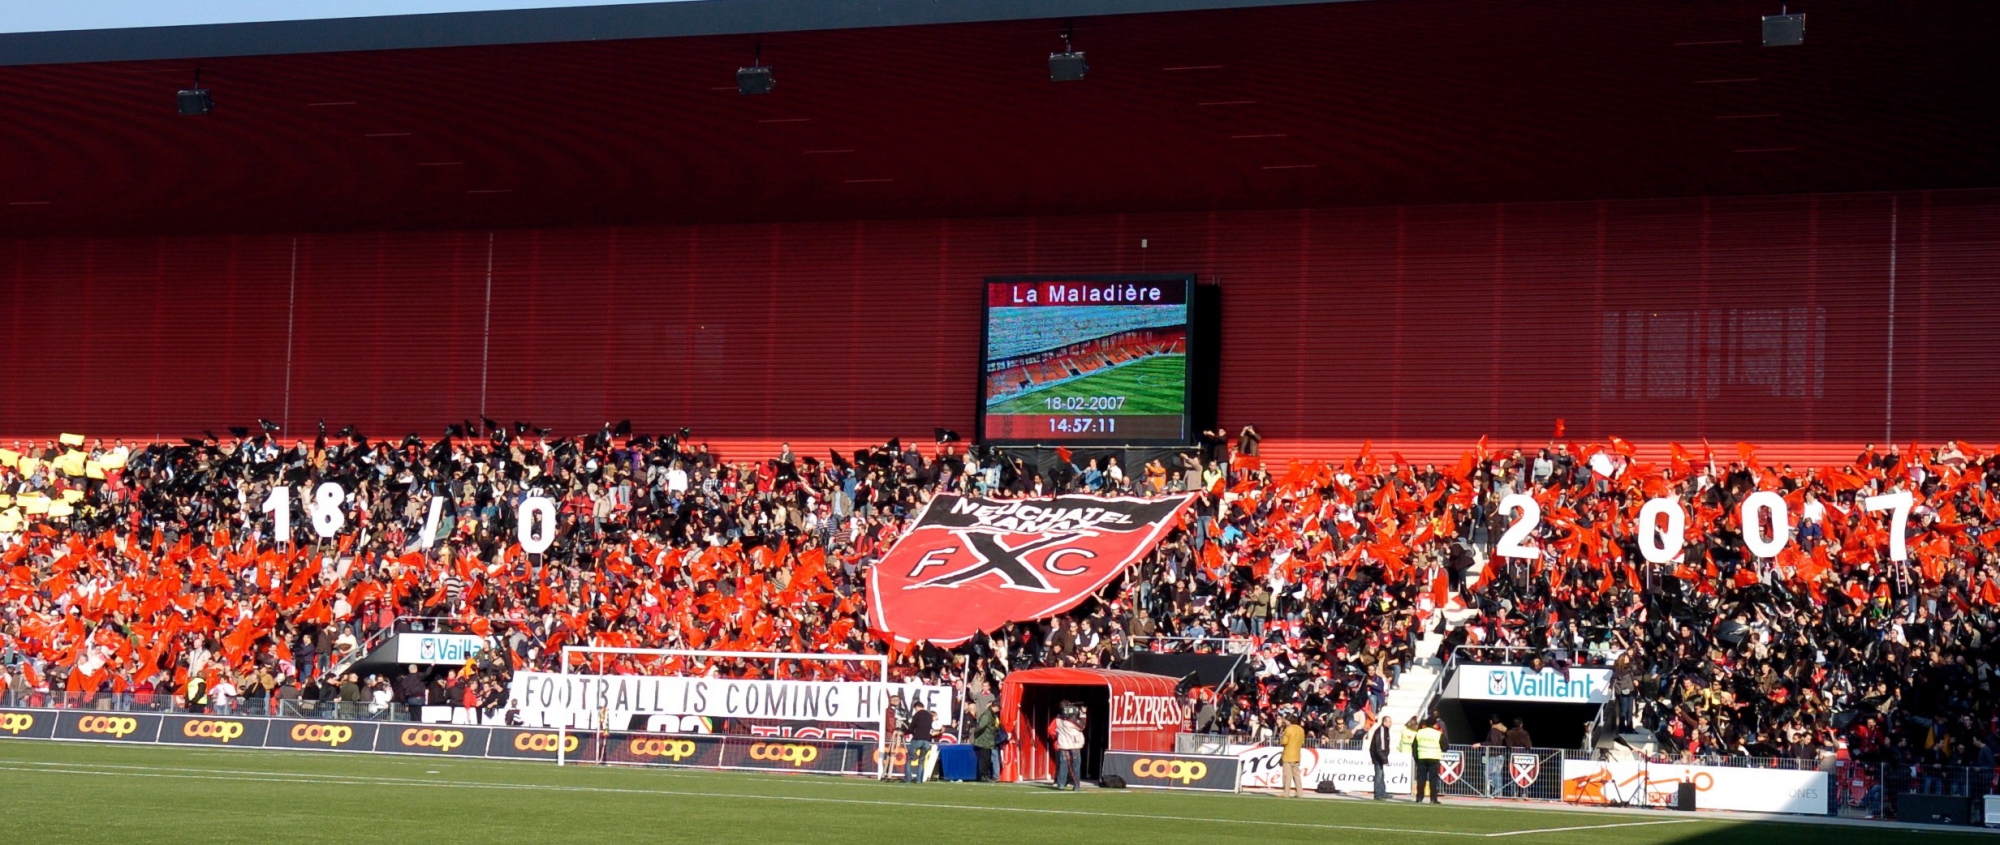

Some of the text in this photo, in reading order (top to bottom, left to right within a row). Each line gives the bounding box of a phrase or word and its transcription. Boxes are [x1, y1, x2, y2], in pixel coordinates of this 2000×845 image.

[1012, 284, 1162, 303] La Maladière
[1044, 396, 1126, 410] 18-02-2007
[1049, 418, 1116, 433] 14:57:11
[262, 482, 345, 542] 18
[437, 638, 484, 660] Vailla
[1510, 671, 1594, 699] Vaillant
[682, 681, 707, 713] IS
[726, 683, 839, 716] COMING
[78, 715, 137, 738] coop
[183, 719, 244, 743] coop
[291, 723, 353, 747] coop
[401, 728, 464, 752] coop
[630, 737, 696, 762] coop
[749, 742, 818, 767] coop
[1132, 758, 1208, 784] coop
[1315, 769, 1408, 784] juraneo.ch
